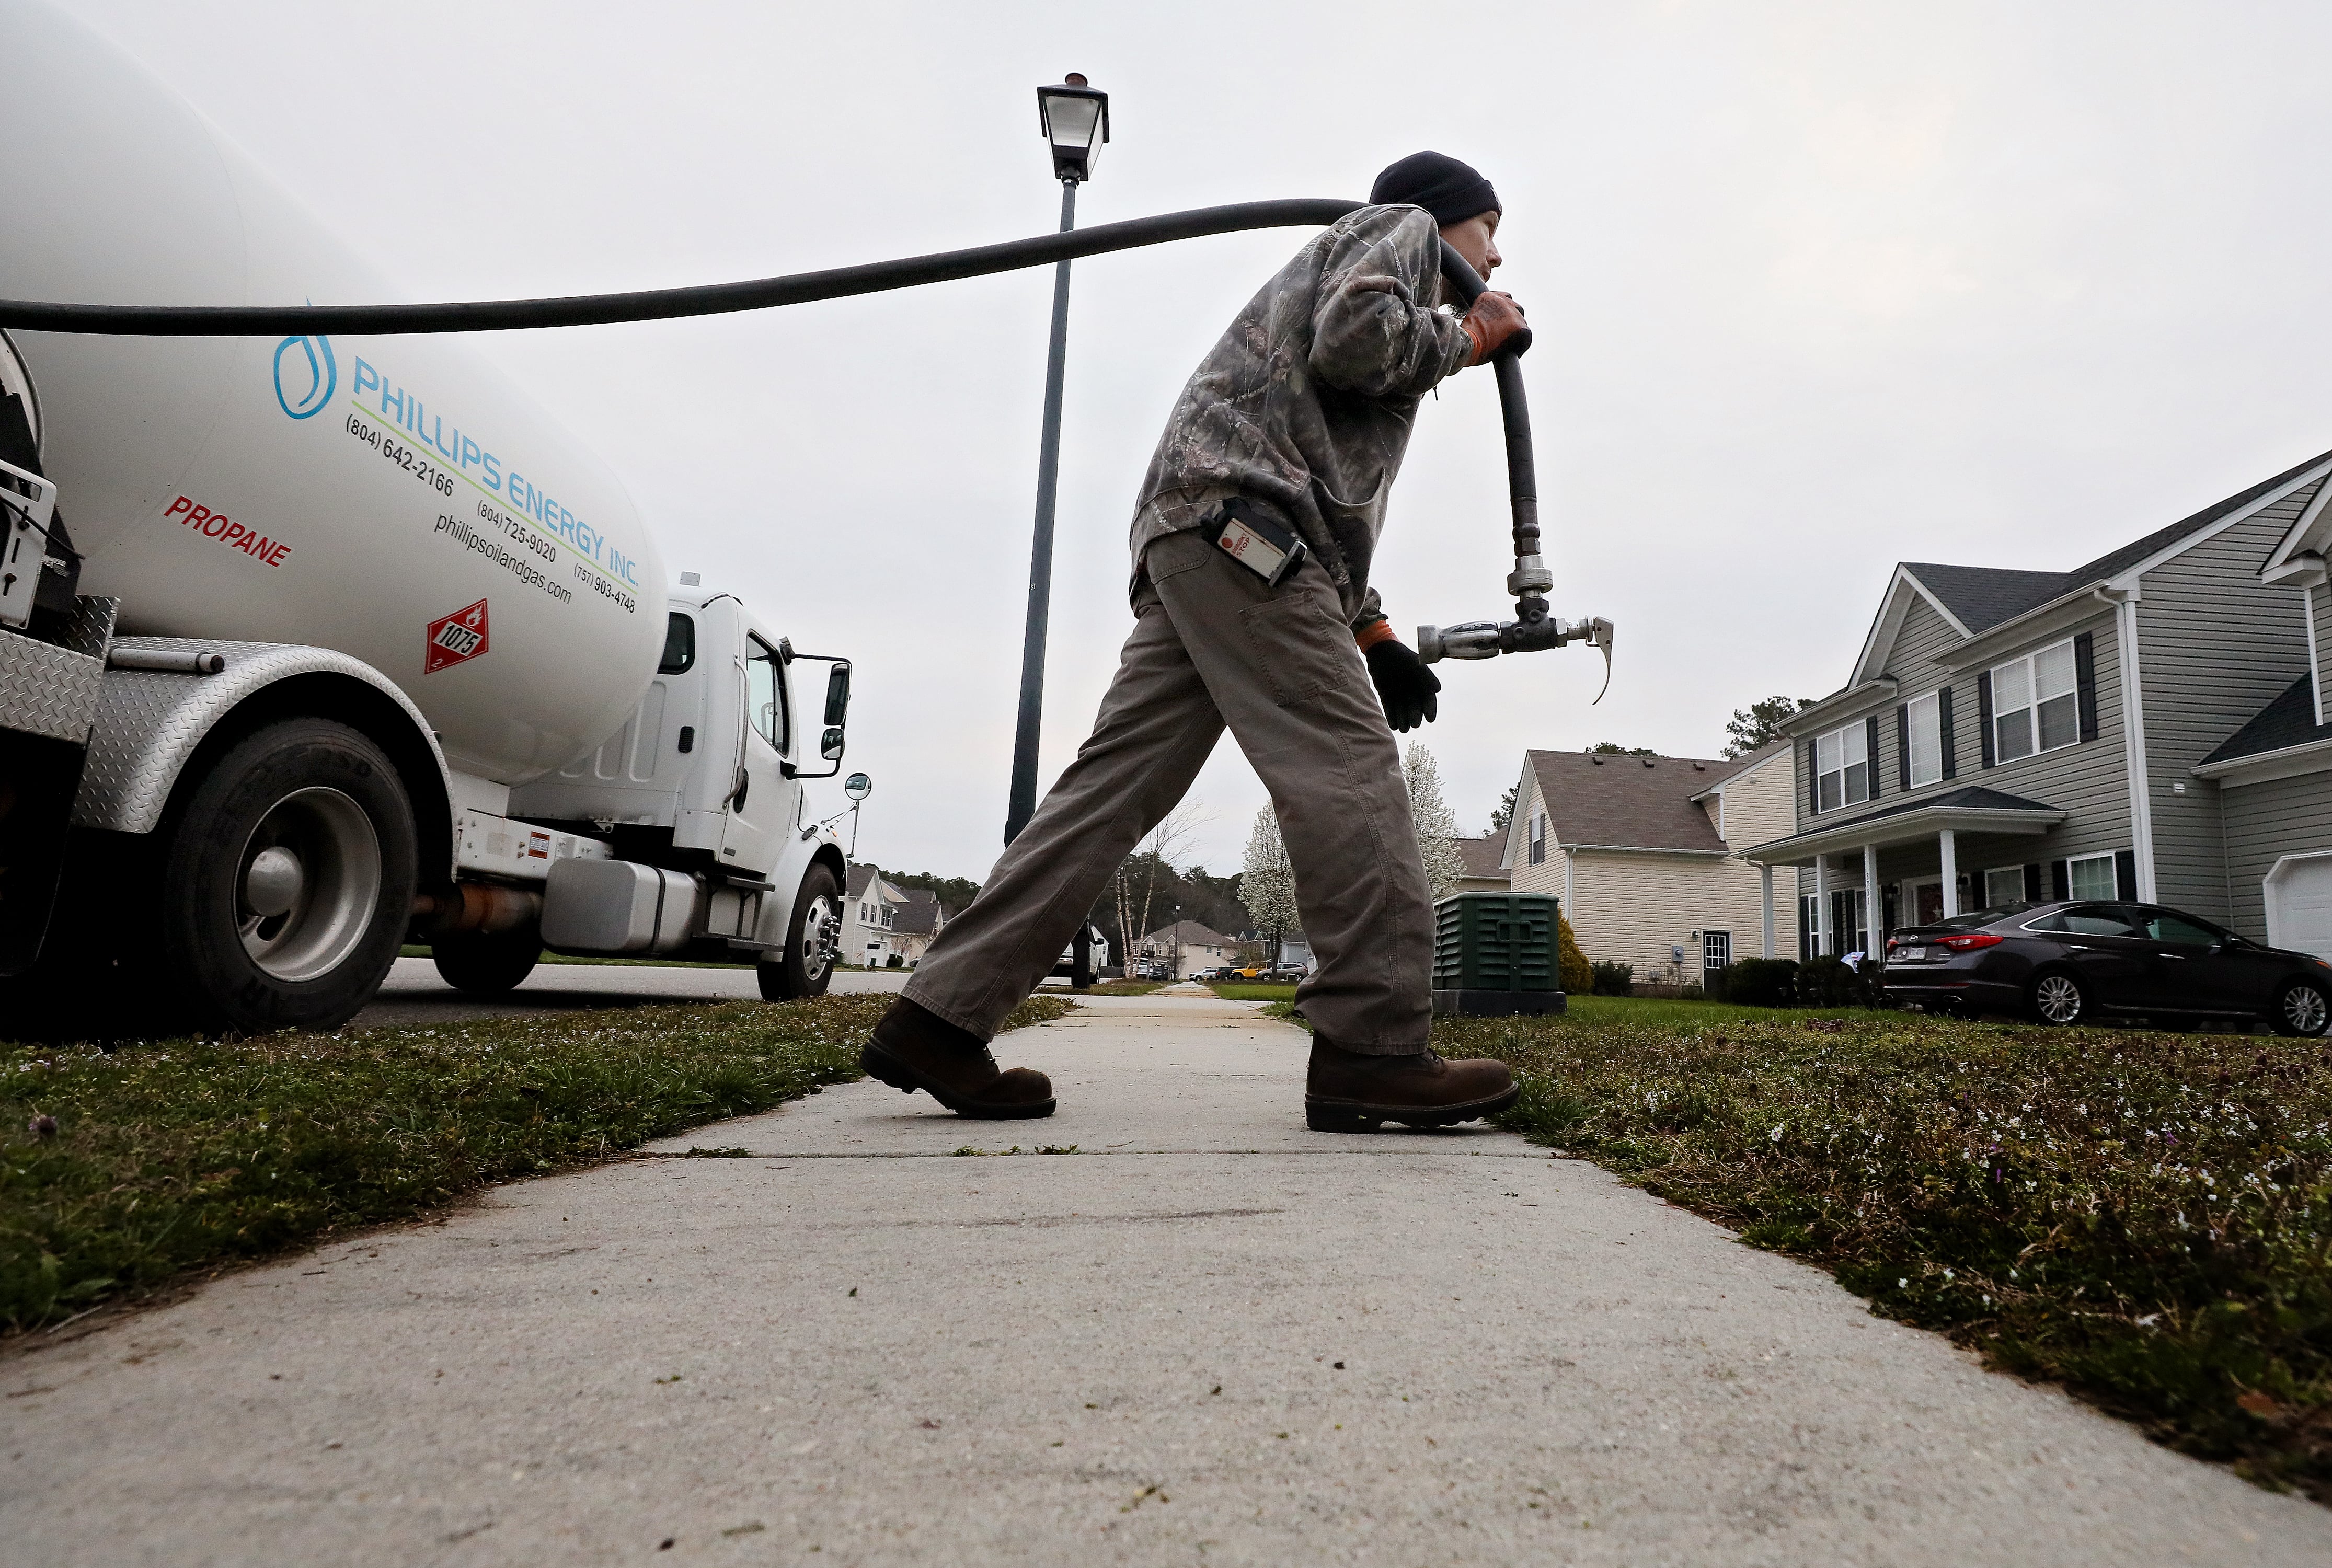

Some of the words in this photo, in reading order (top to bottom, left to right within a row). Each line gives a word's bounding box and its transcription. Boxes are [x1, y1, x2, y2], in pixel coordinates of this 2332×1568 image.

[353, 356, 501, 490] PHILLIPS
[509, 472, 604, 560] ENERGY
[610, 547, 638, 586] INC.
[164, 495, 291, 568] PROPANE
[346, 413, 381, 450] (804)
[383, 439, 454, 497] 642-2166
[477, 500, 502, 528] (804)
[504, 516, 556, 562] 725-9020
[574, 563, 594, 586] (757)
[594, 577, 635, 613] 903-4748
[1236, 537, 1249, 557] STOP
[434, 514, 572, 604] phillipsoilandgas.com
[431, 658, 443, 667] 2
[439, 624, 479, 654] 1075
